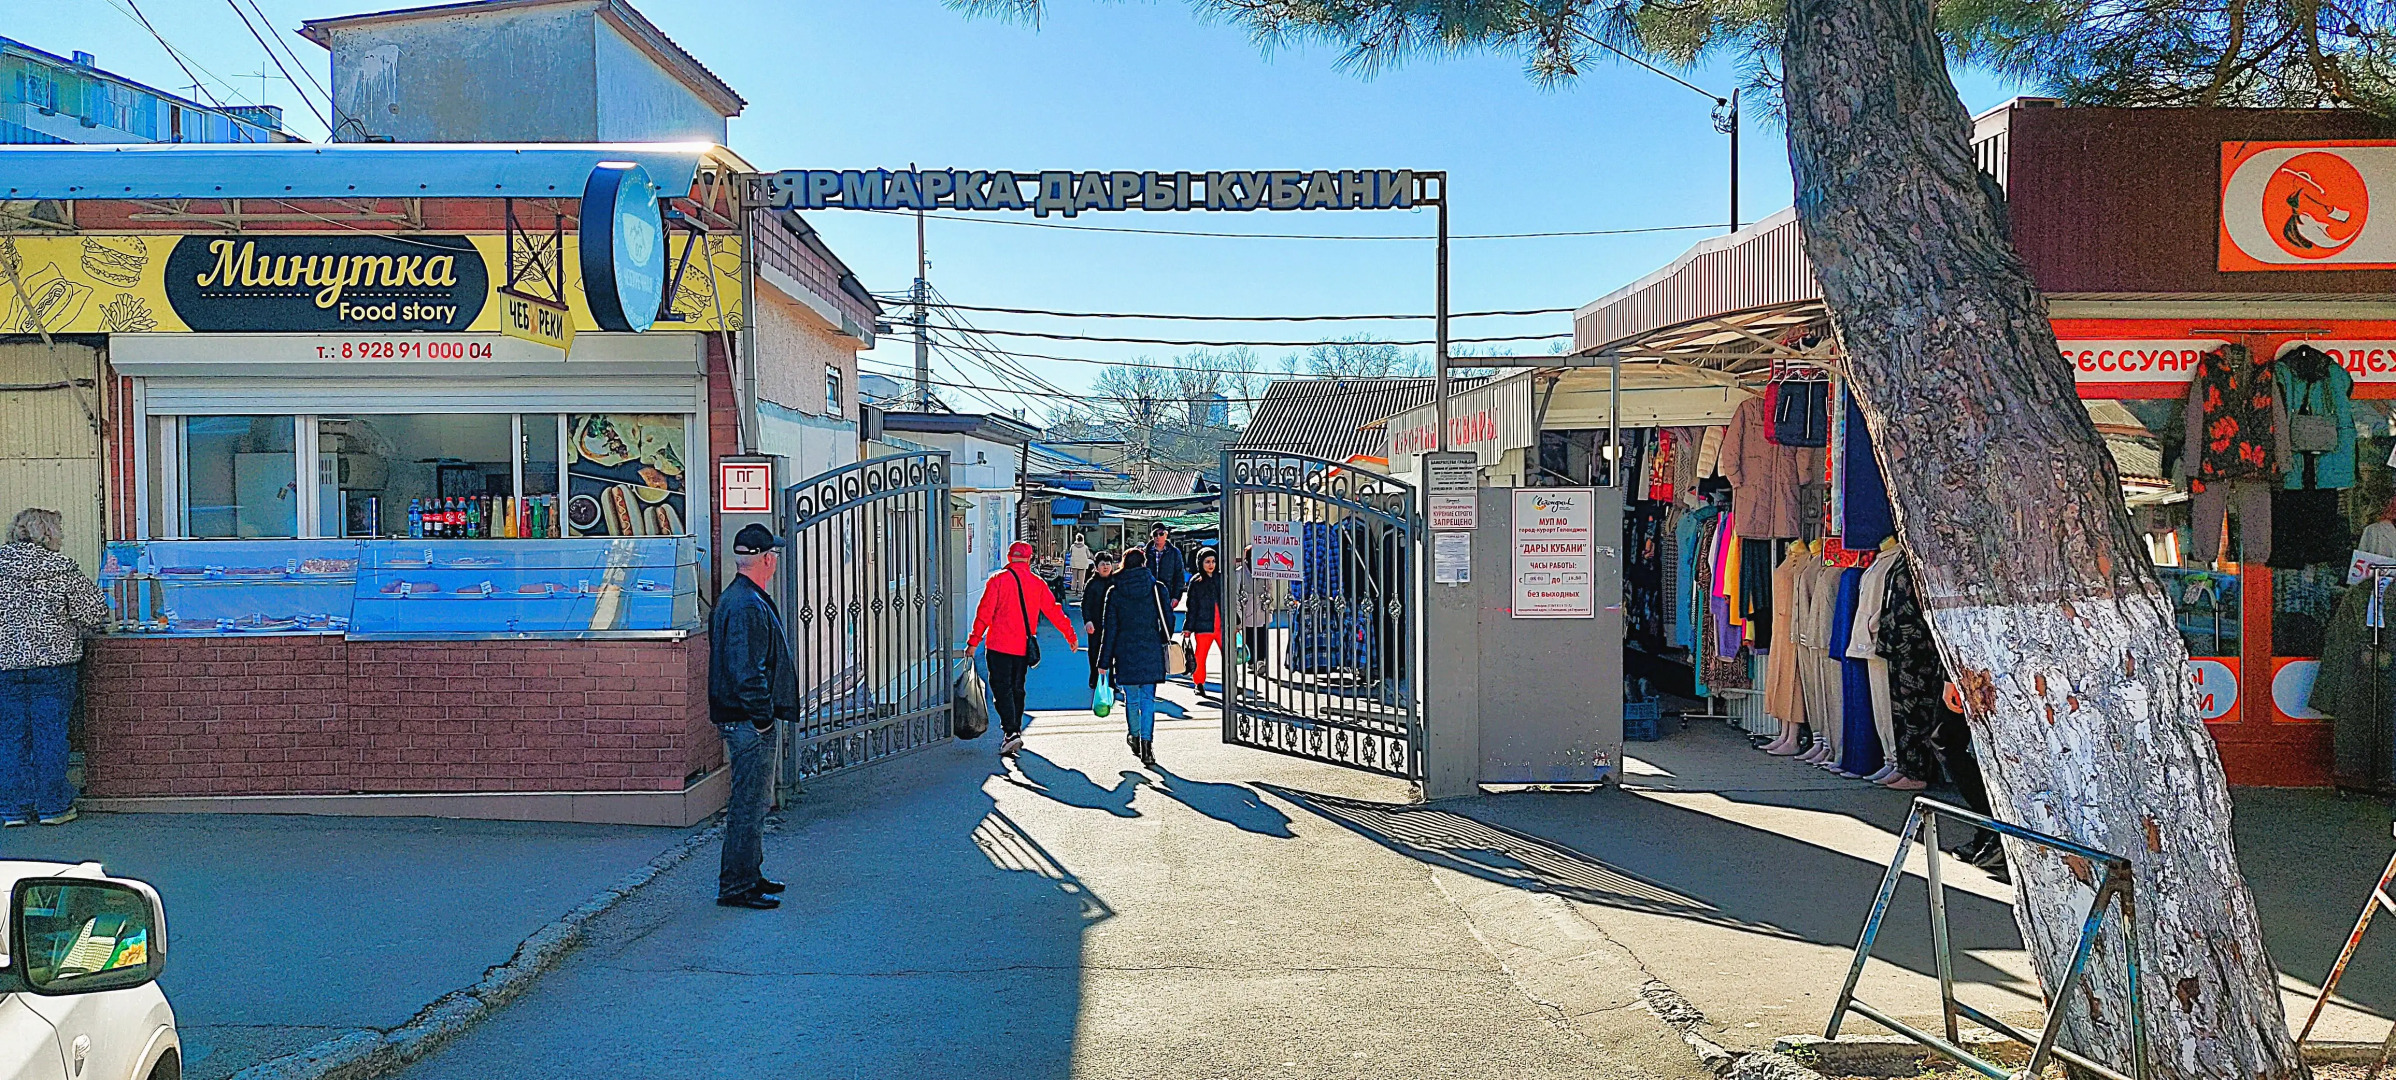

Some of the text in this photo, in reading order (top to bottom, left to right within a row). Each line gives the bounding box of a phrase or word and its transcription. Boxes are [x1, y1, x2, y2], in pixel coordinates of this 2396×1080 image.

[771, 170, 1413, 218] ЯРМАРКА ДАРЫ КУБАНИ
[197, 240, 456, 308] Минутка
[340, 302, 456, 323] Food story
[342, 342, 352, 358] 8
[359, 342, 394, 358] 928
[399, 342, 420, 358] 91
[428, 342, 463, 358] 000
[469, 342, 492, 358] 04
[1449, 407, 1497, 446] ТОВАРЫ
[737, 471, 754, 482] ПГ
[1264, 524, 1289, 534] ПРОЕЗД
[1253, 535, 1261, 544] НЕ
